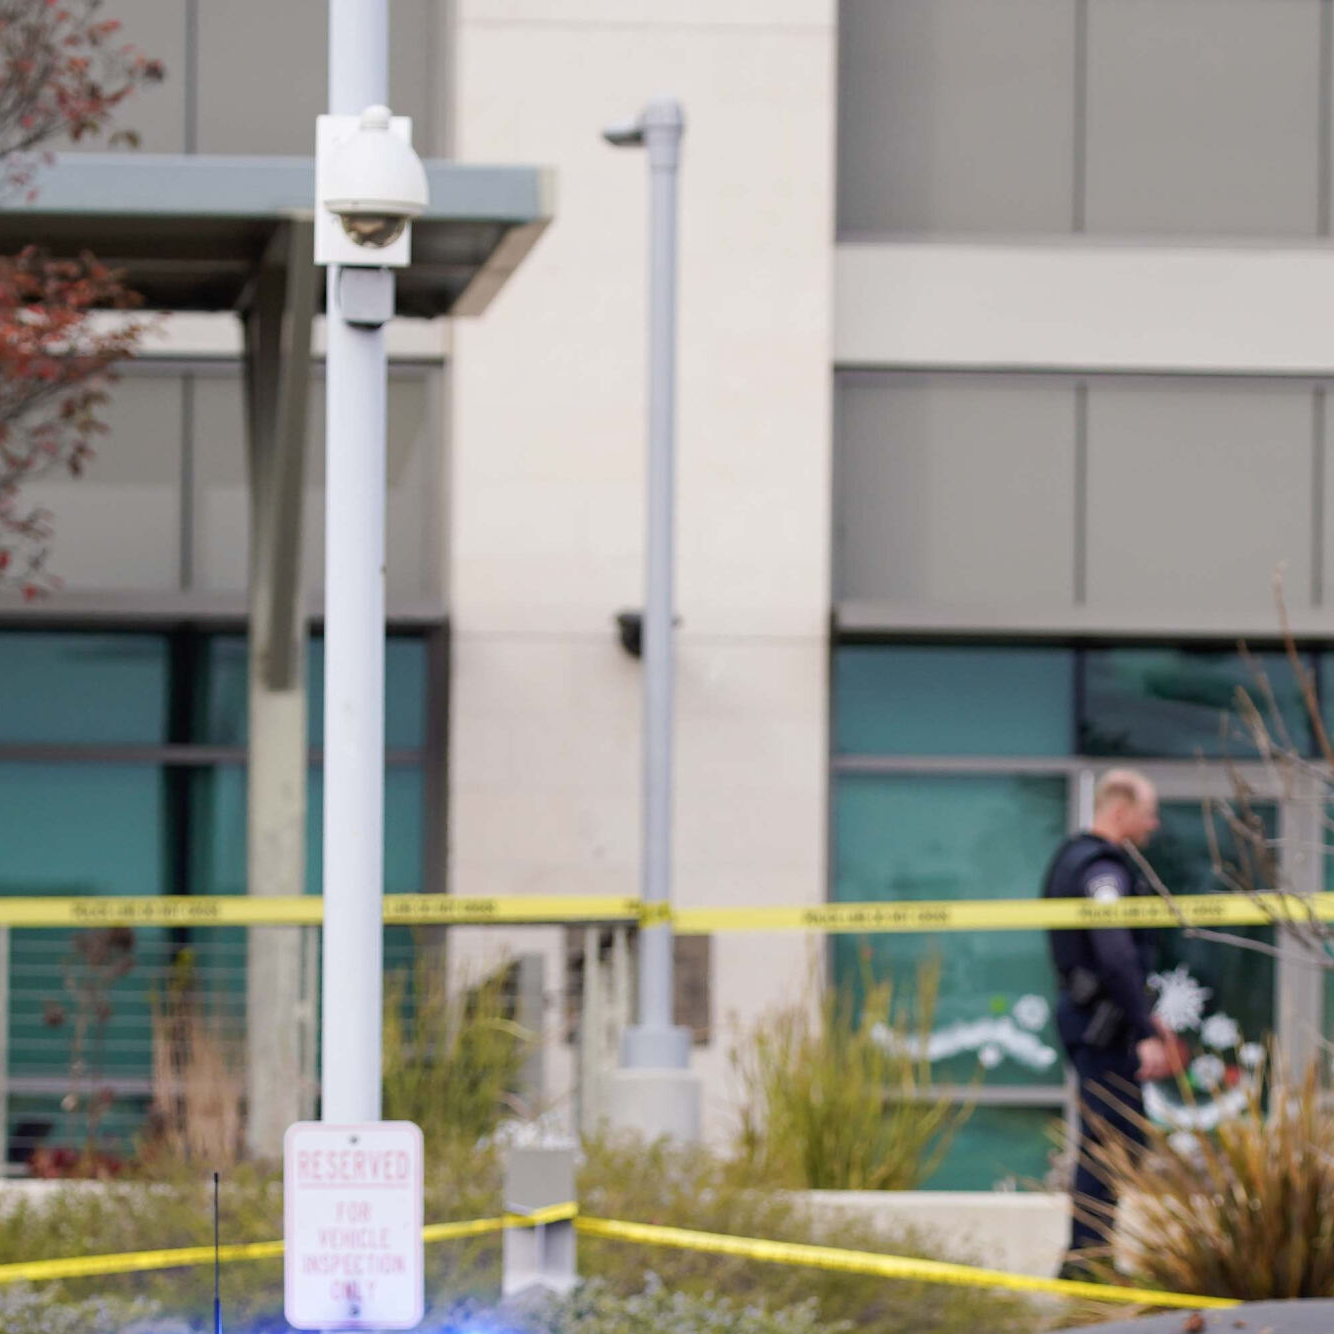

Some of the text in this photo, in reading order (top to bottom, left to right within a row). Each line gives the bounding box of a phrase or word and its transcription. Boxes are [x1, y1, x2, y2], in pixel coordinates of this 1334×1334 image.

[297, 1150, 410, 1180] RESERVED
[336, 1201, 371, 1221] FOR
[319, 1228, 391, 1249] VEHICLE
[302, 1254, 405, 1275] INSPECTION
[331, 1280, 376, 1302] ONLY
